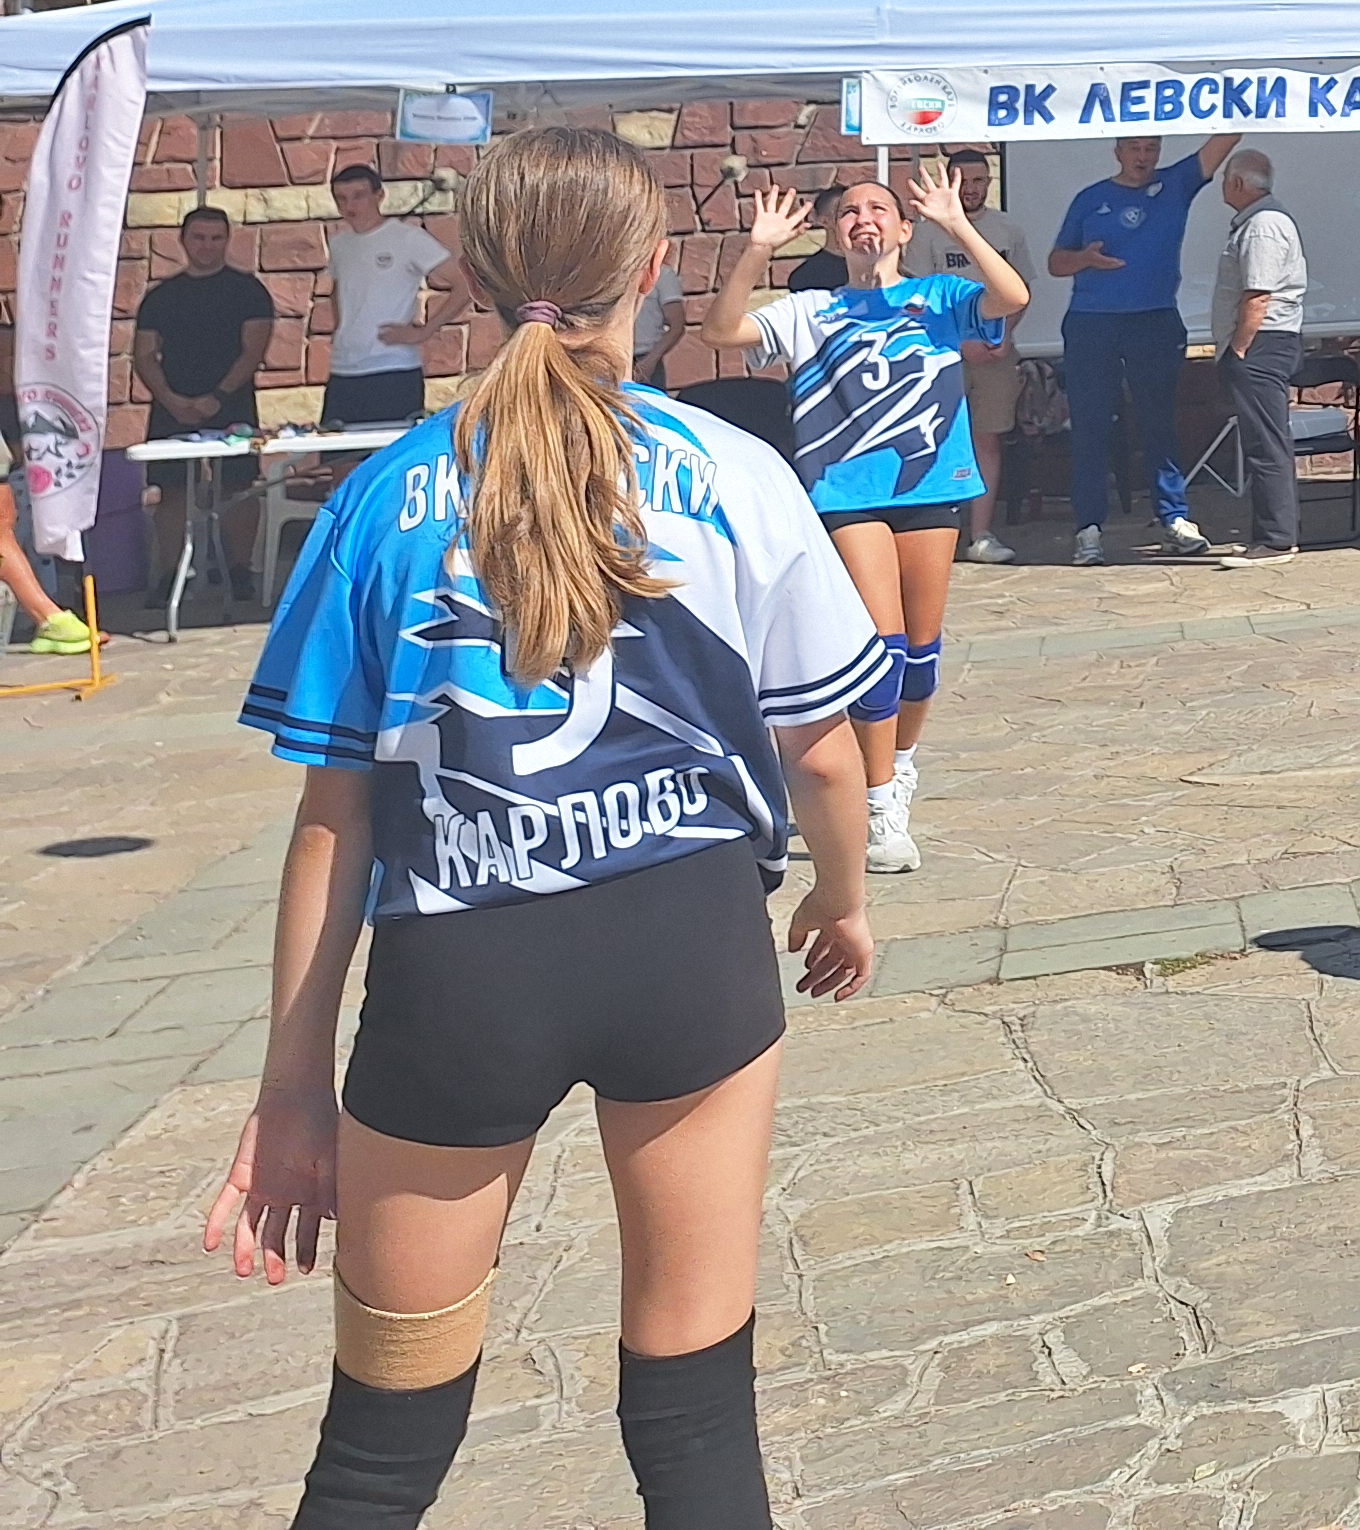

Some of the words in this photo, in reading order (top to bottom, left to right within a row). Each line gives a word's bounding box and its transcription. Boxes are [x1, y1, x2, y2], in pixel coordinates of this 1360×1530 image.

[987, 83, 1058, 126] ВК
[1078, 76, 1287, 125] ЛЕВСКИ
[859, 330, 892, 391] 3
[433, 766, 710, 889] КАРЛОВО
